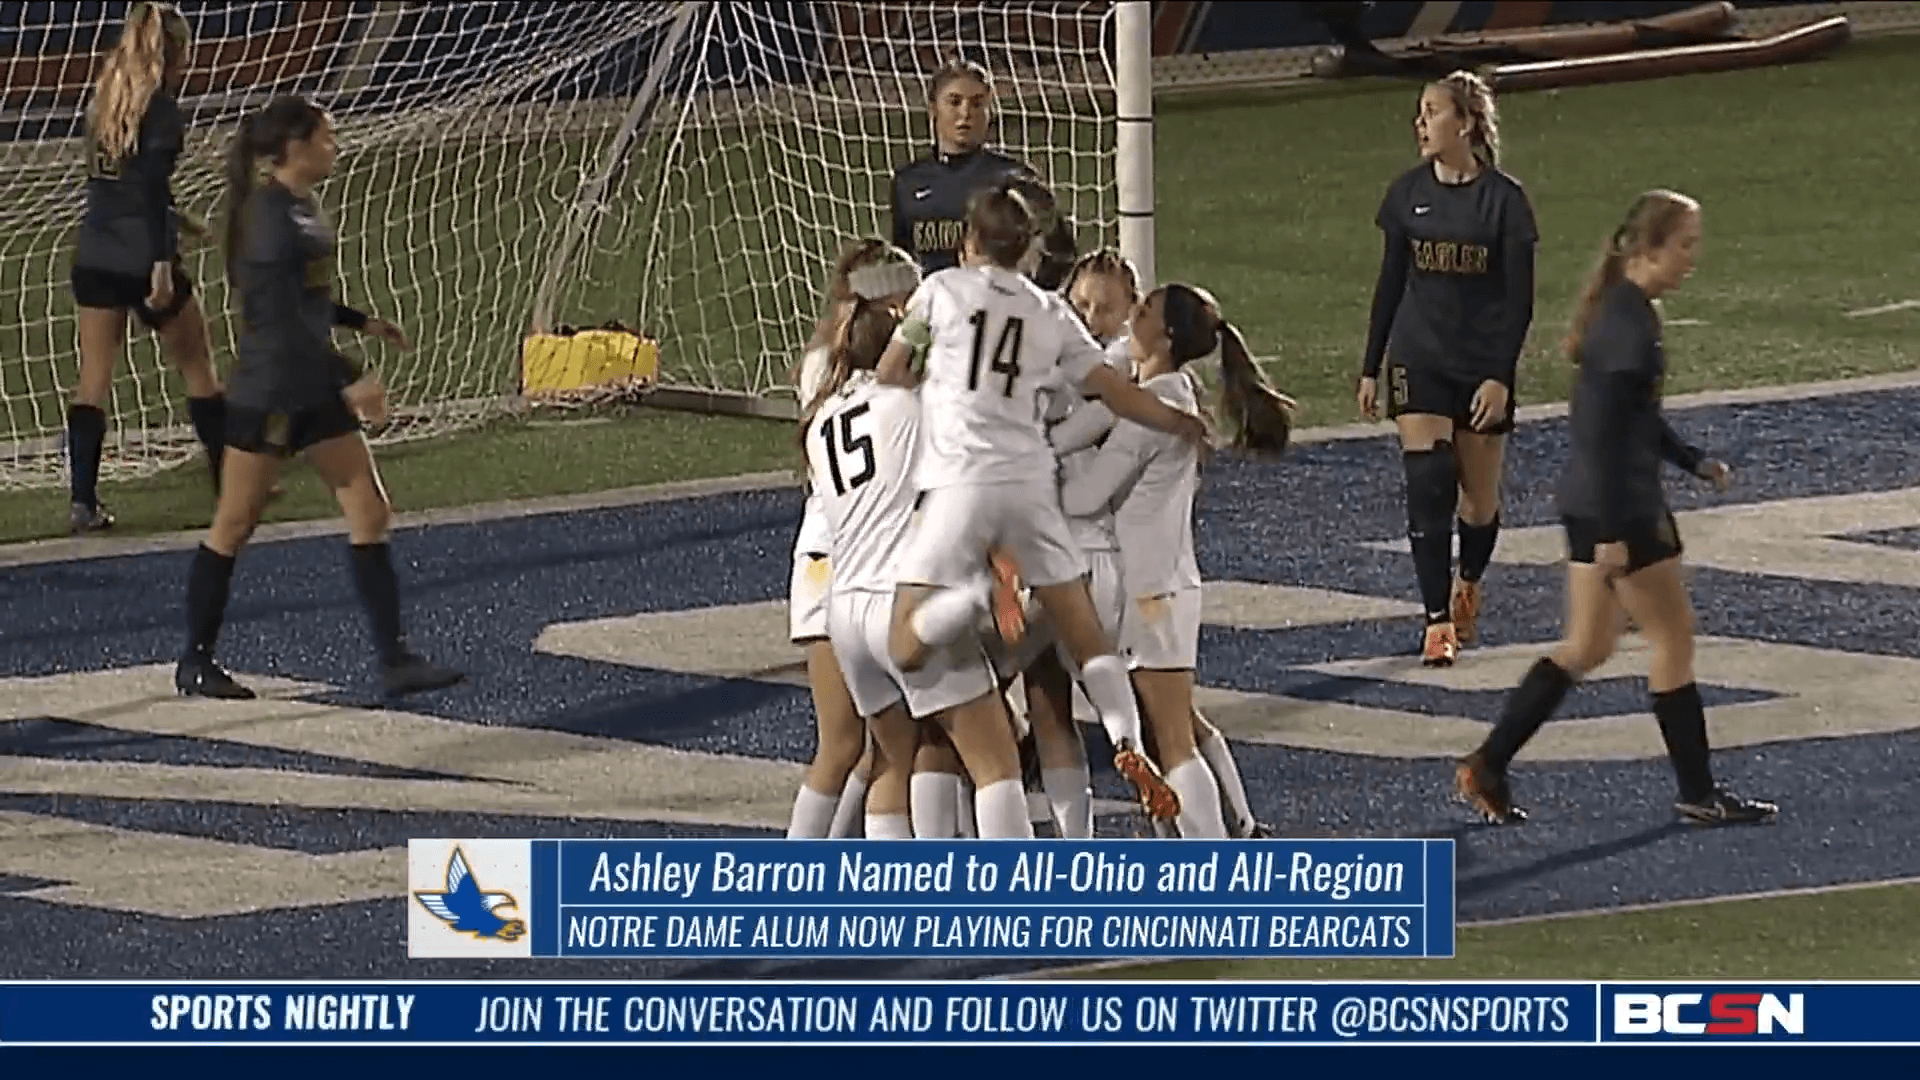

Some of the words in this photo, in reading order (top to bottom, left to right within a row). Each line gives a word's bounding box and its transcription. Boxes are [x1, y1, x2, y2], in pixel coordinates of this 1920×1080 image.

[1410, 238, 1489, 274] EAGLES
[968, 309, 1024, 398] 14
[1392, 366, 1409, 405] 5
[820, 401, 876, 496] 15
